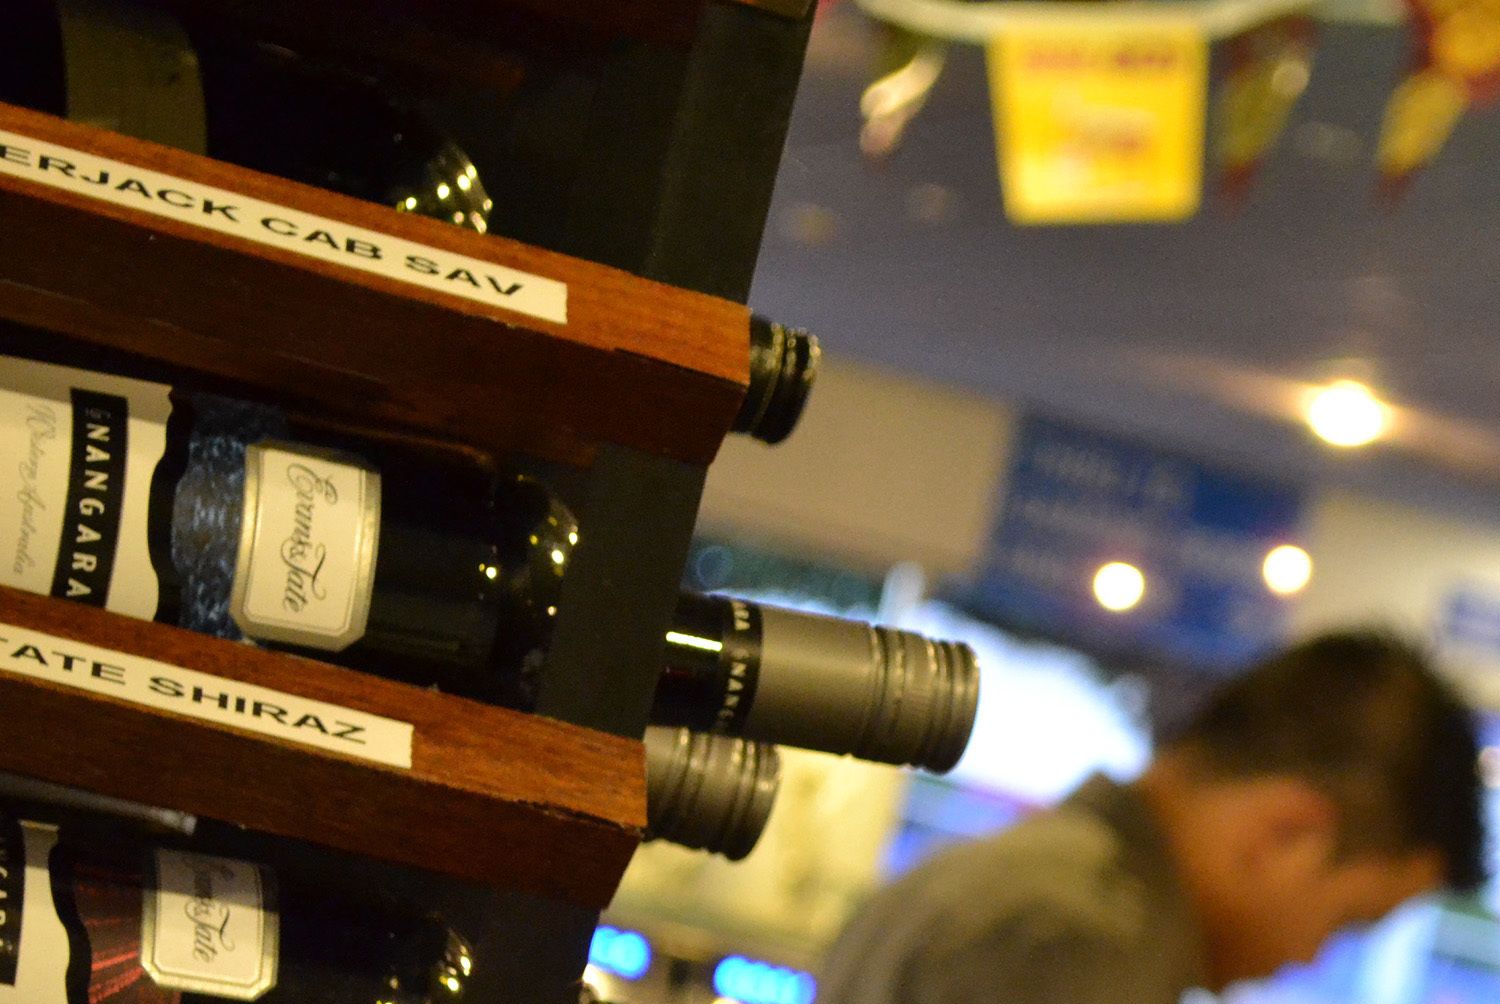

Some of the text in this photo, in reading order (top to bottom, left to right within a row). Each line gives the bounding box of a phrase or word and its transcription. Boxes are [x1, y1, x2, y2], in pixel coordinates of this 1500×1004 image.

[0, 144, 524, 297] ERJACK CAB SAV
[280, 540, 328, 613] Tate
[0, 636, 367, 746] ATE SHIRAZ
